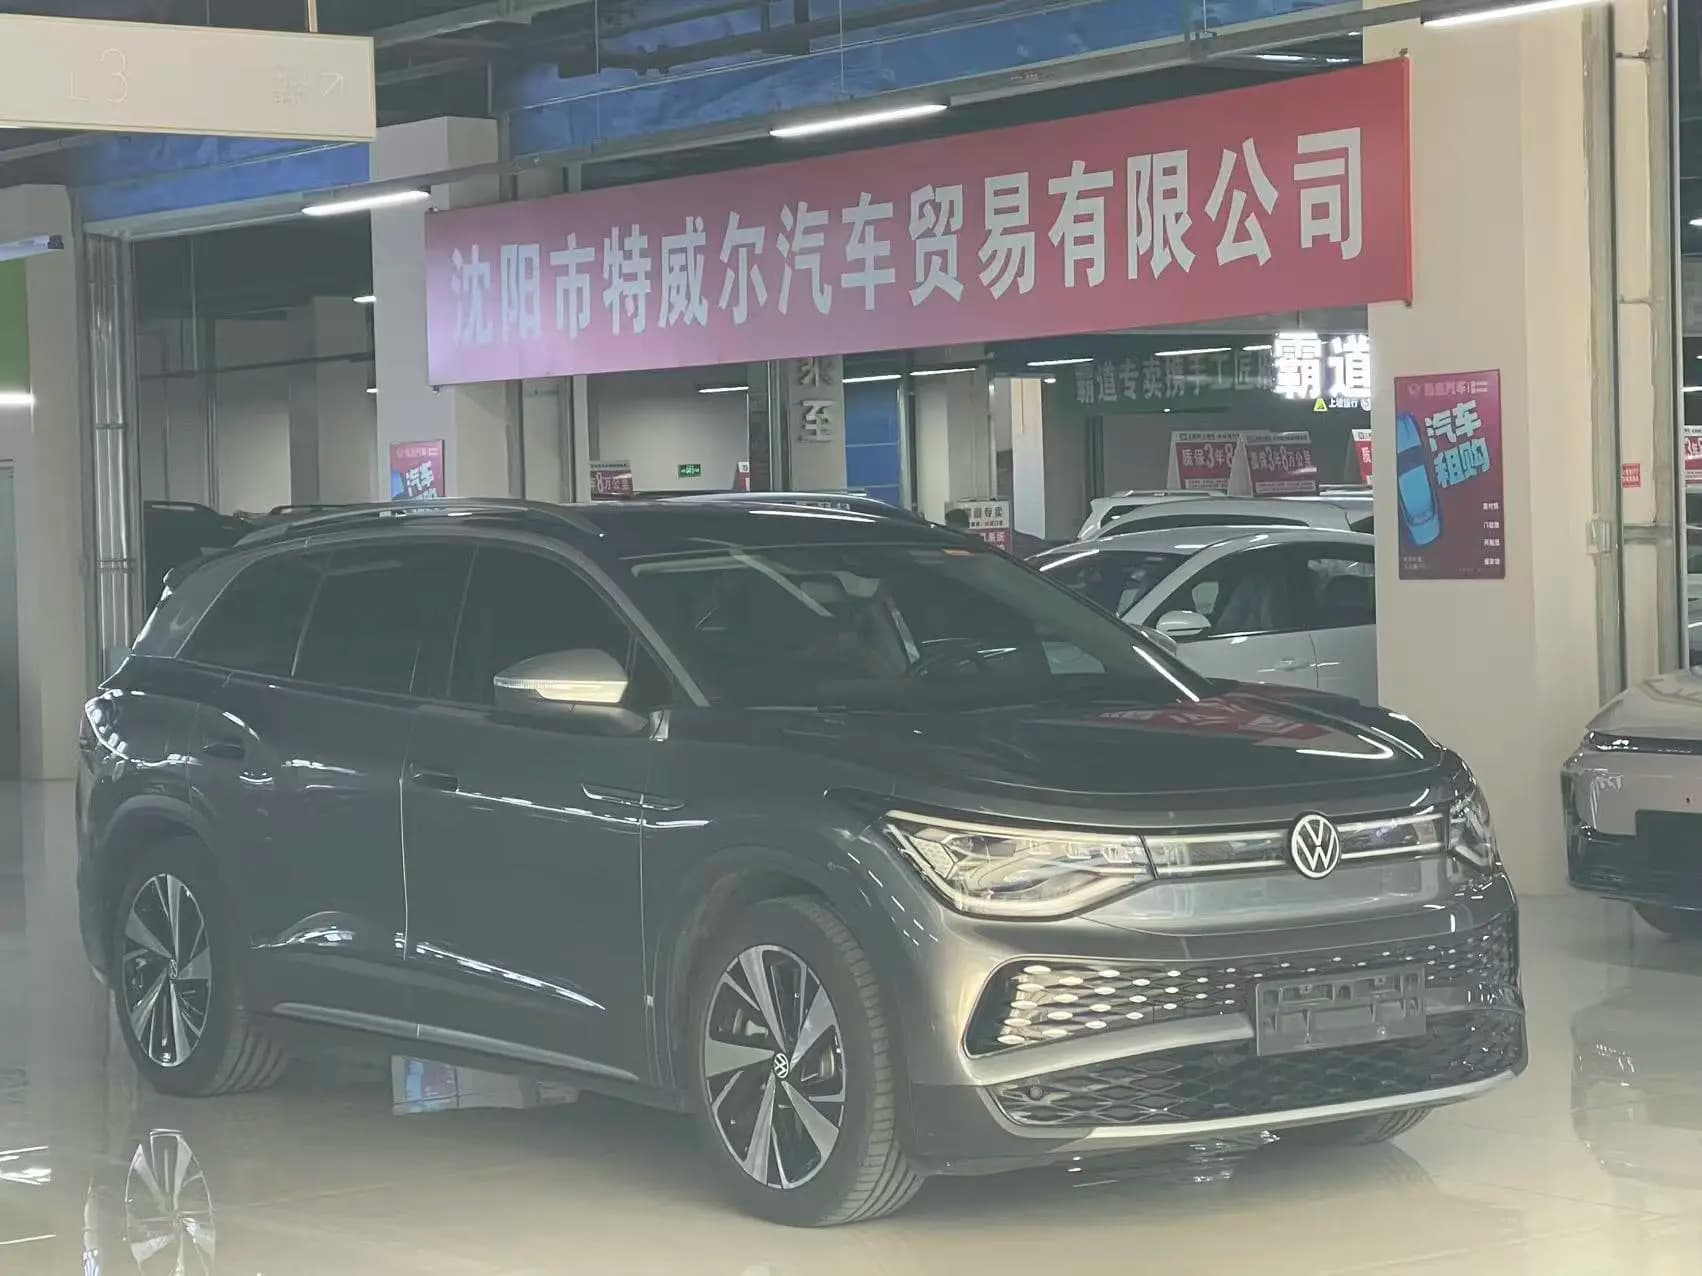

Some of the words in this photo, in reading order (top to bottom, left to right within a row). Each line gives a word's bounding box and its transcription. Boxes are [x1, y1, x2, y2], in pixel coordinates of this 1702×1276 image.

[68, 47, 129, 104] L3
[450, 126, 1364, 346] 沈阳市特威尔汽车贸易有限公司
[1273, 332, 1371, 399] 霸道
[1423, 399, 1482, 451] 汽车
[405, 460, 435, 498] 汽车
